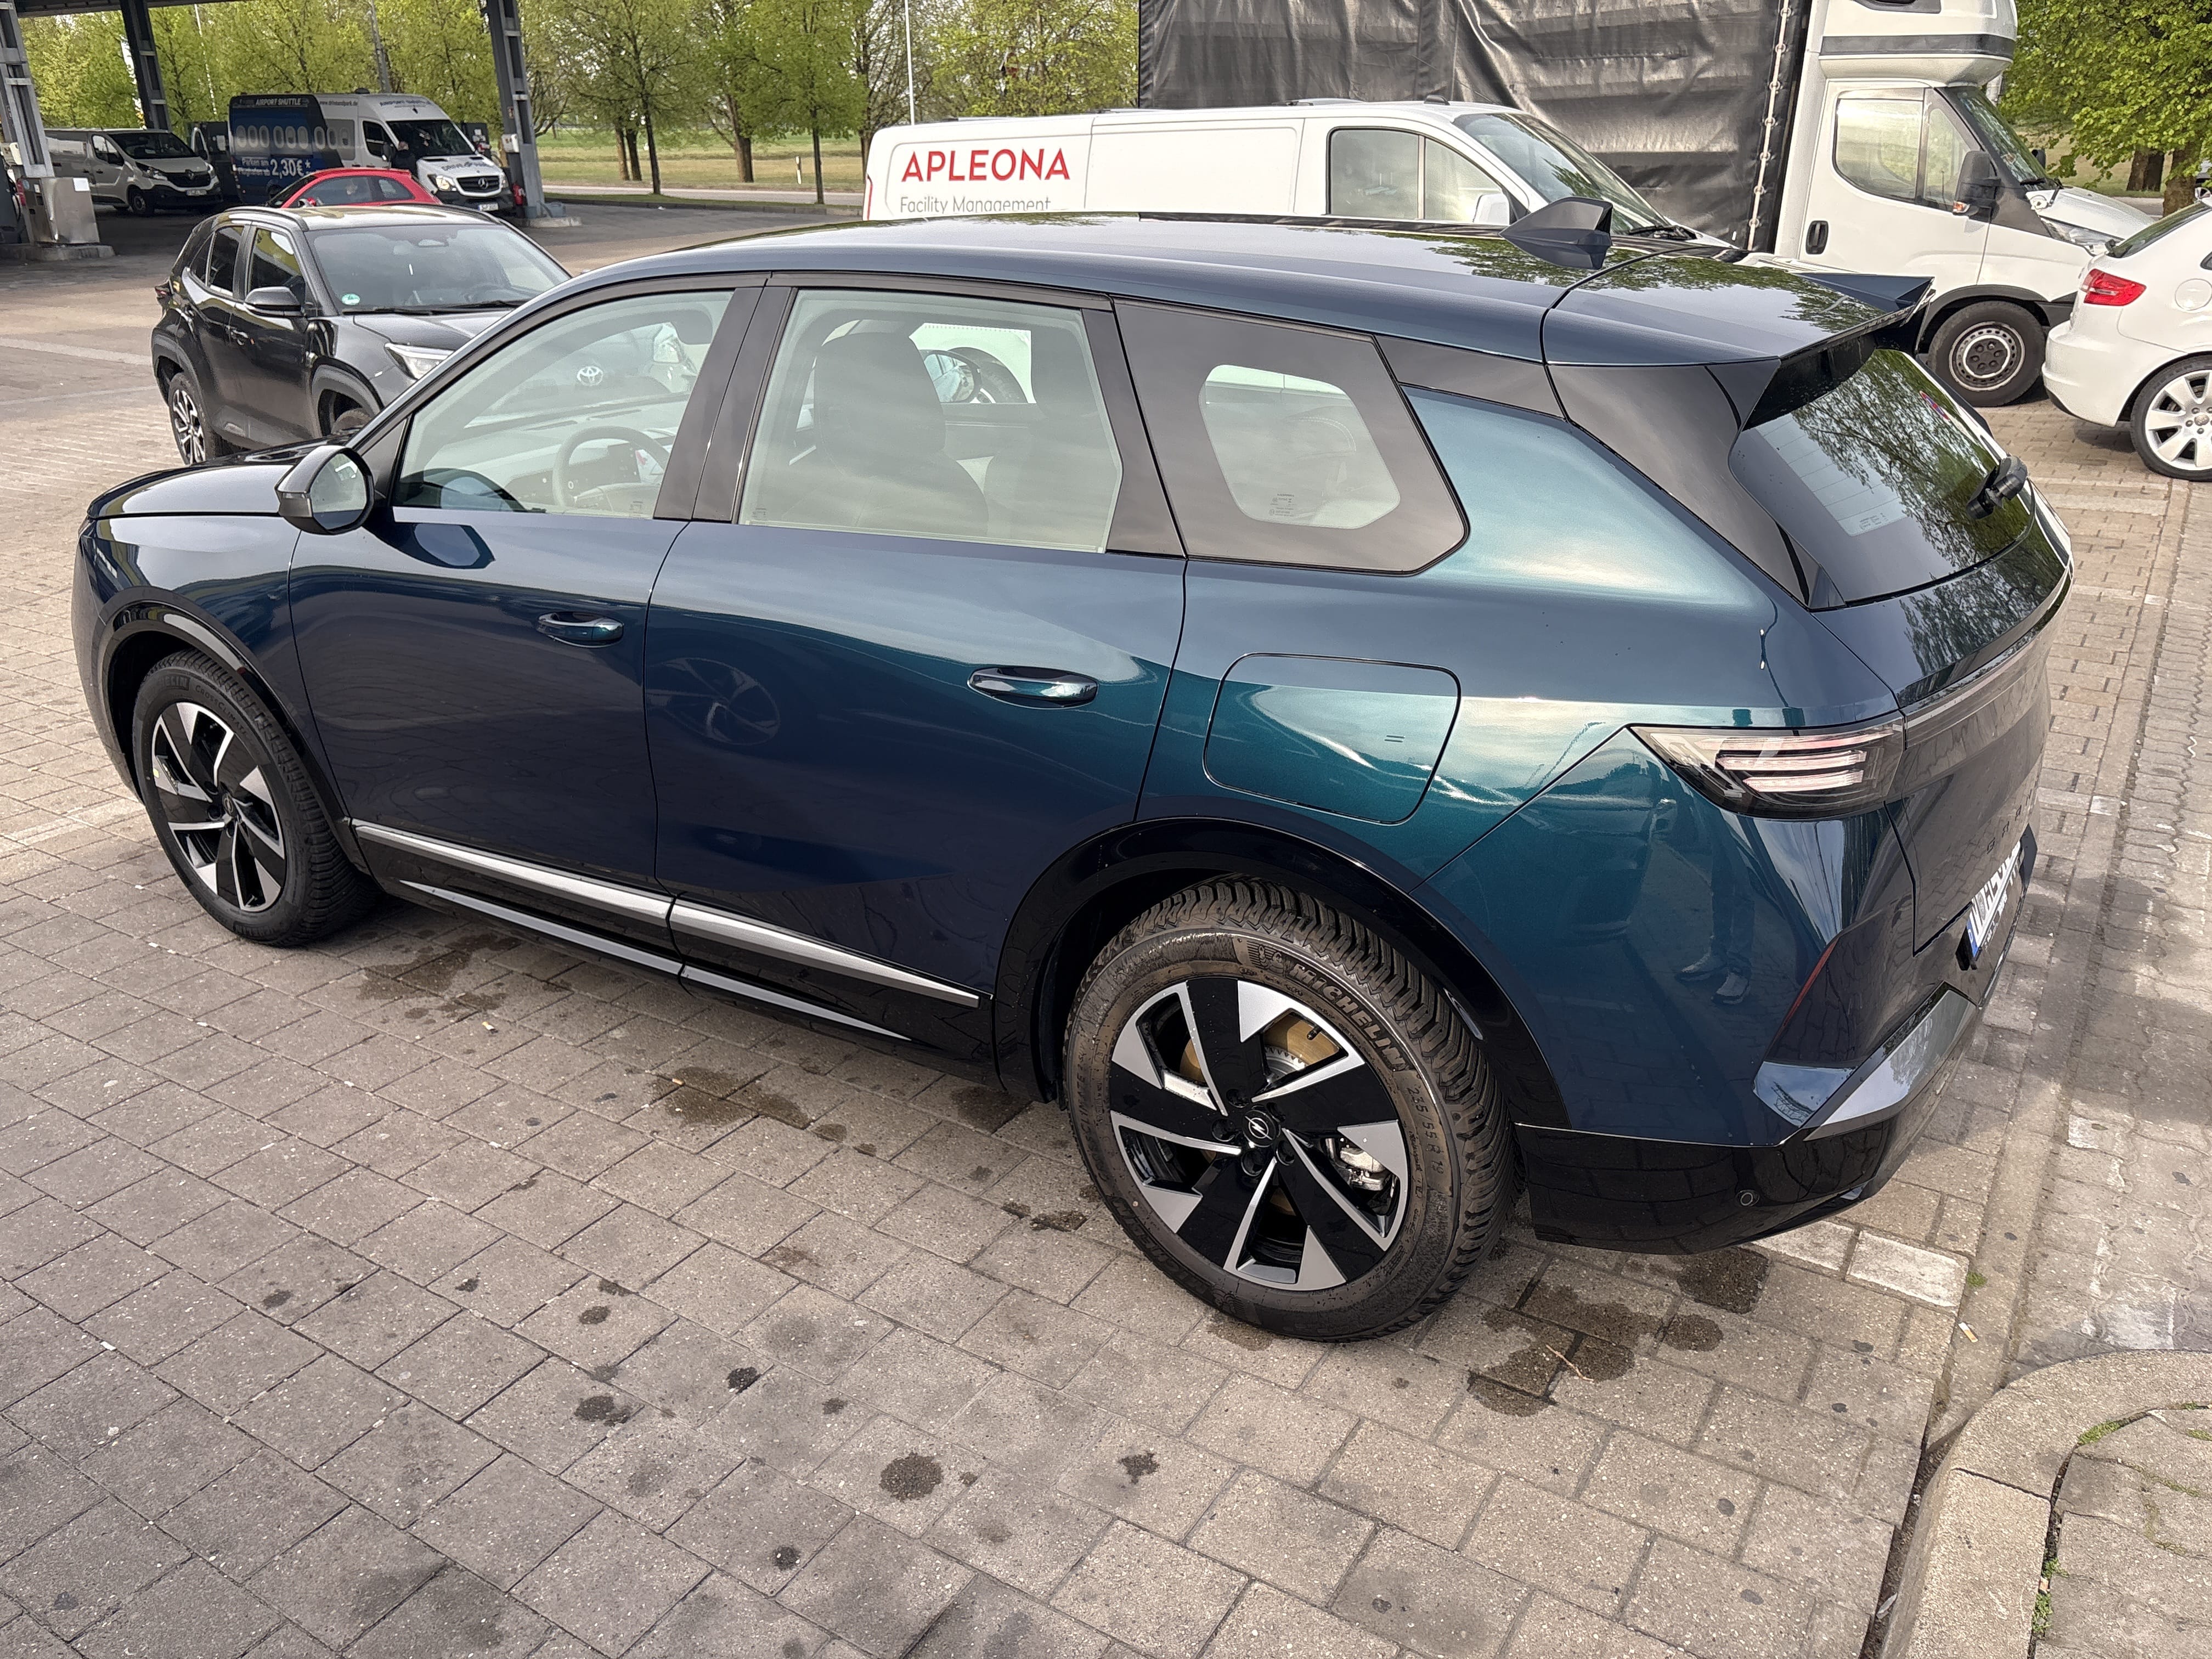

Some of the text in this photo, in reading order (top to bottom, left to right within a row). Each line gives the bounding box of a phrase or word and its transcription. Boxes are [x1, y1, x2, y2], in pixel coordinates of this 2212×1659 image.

[901, 148, 1070, 182] APLEONA
[900, 196, 949, 214] Facility
[1291, 963, 1406, 1065] MICHELIN
[1406, 1086, 1437, 1139] 235/55
